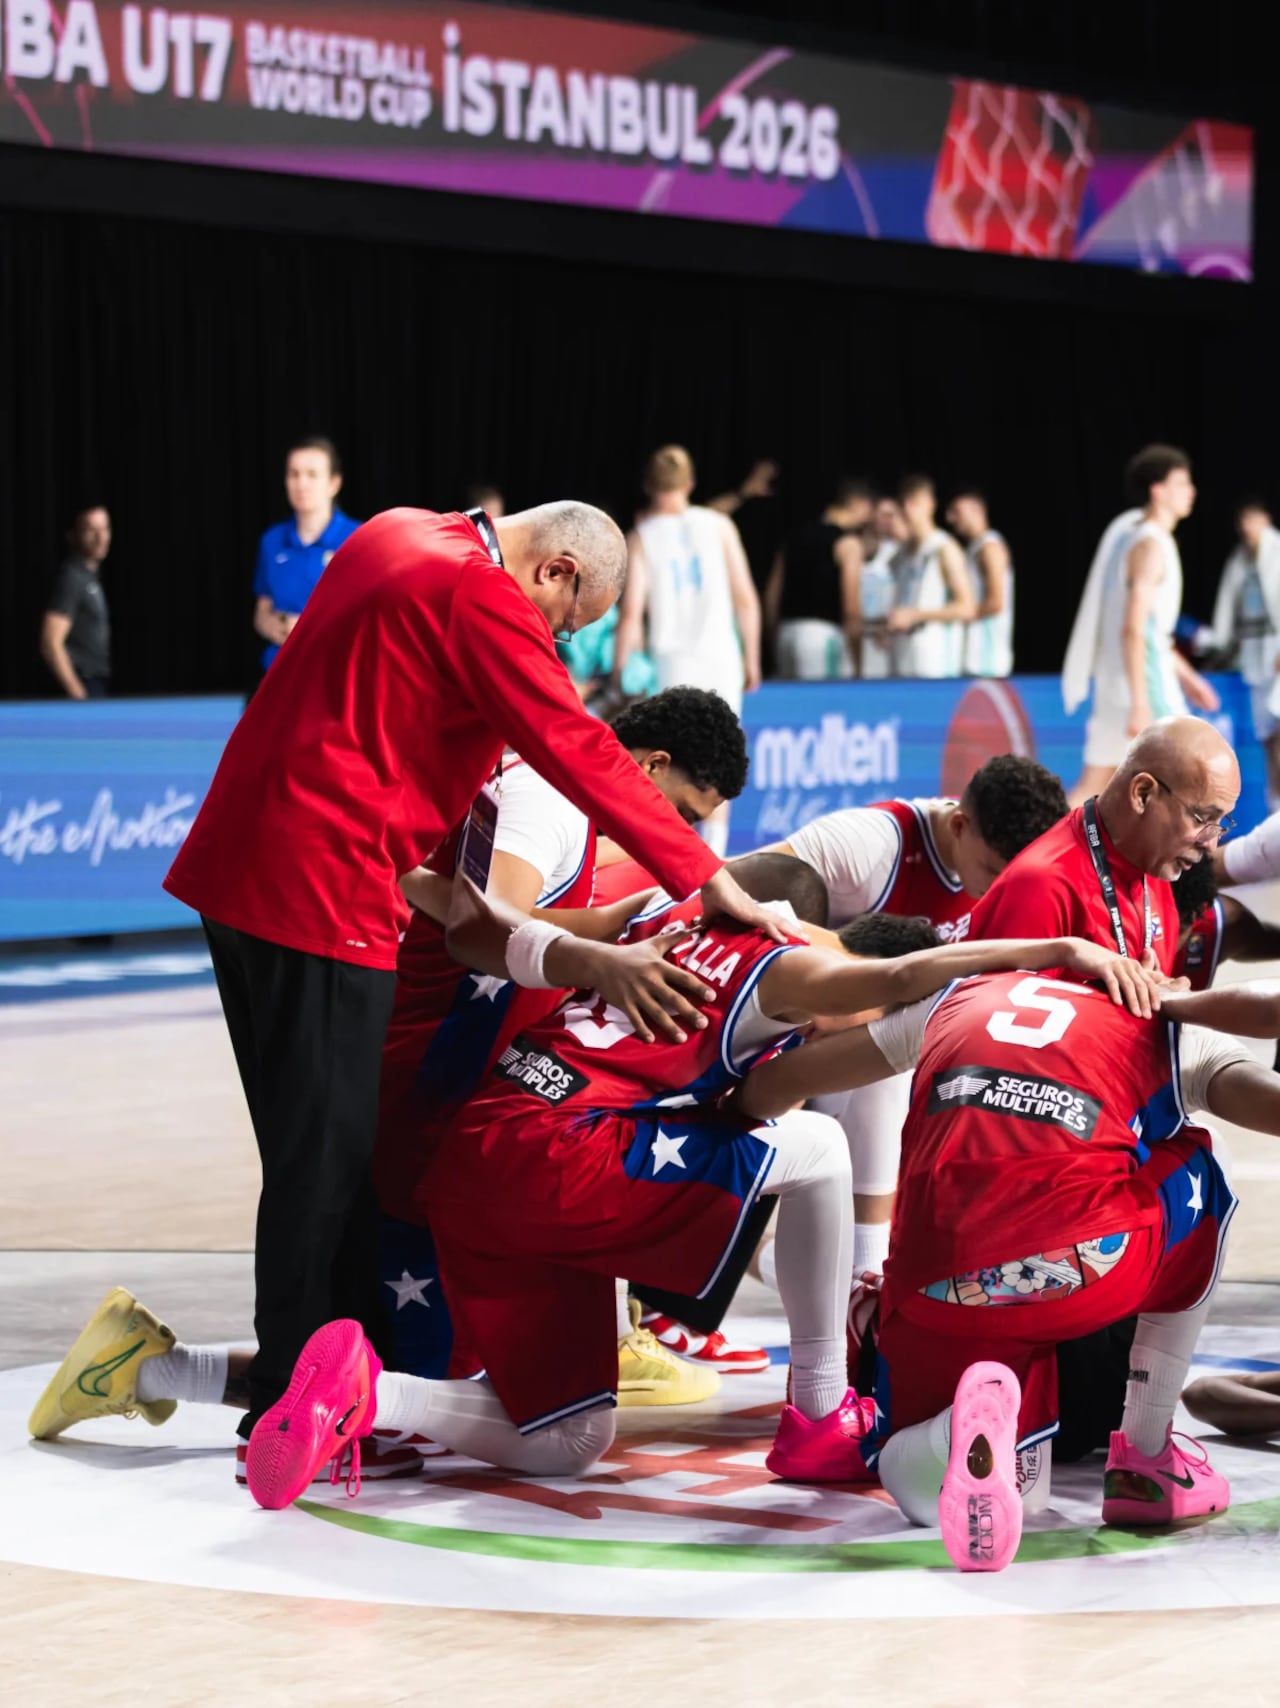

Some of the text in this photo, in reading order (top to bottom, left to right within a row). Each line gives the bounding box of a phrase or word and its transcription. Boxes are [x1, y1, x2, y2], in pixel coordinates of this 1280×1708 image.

[122, 4, 232, 101] U17
[246, 21, 432, 87] BASKETBALL
[246, 66, 432, 128] WORLD CUP
[442, 21, 840, 180] İSTANBUL 2026
[755, 713, 899, 790] molten
[985, 975, 1094, 1049] 5
[981, 1089, 1088, 1131] MULTIPLES
[996, 1075, 1085, 1113] SEGUROS
[979, 1493, 994, 1562] ZOOM
